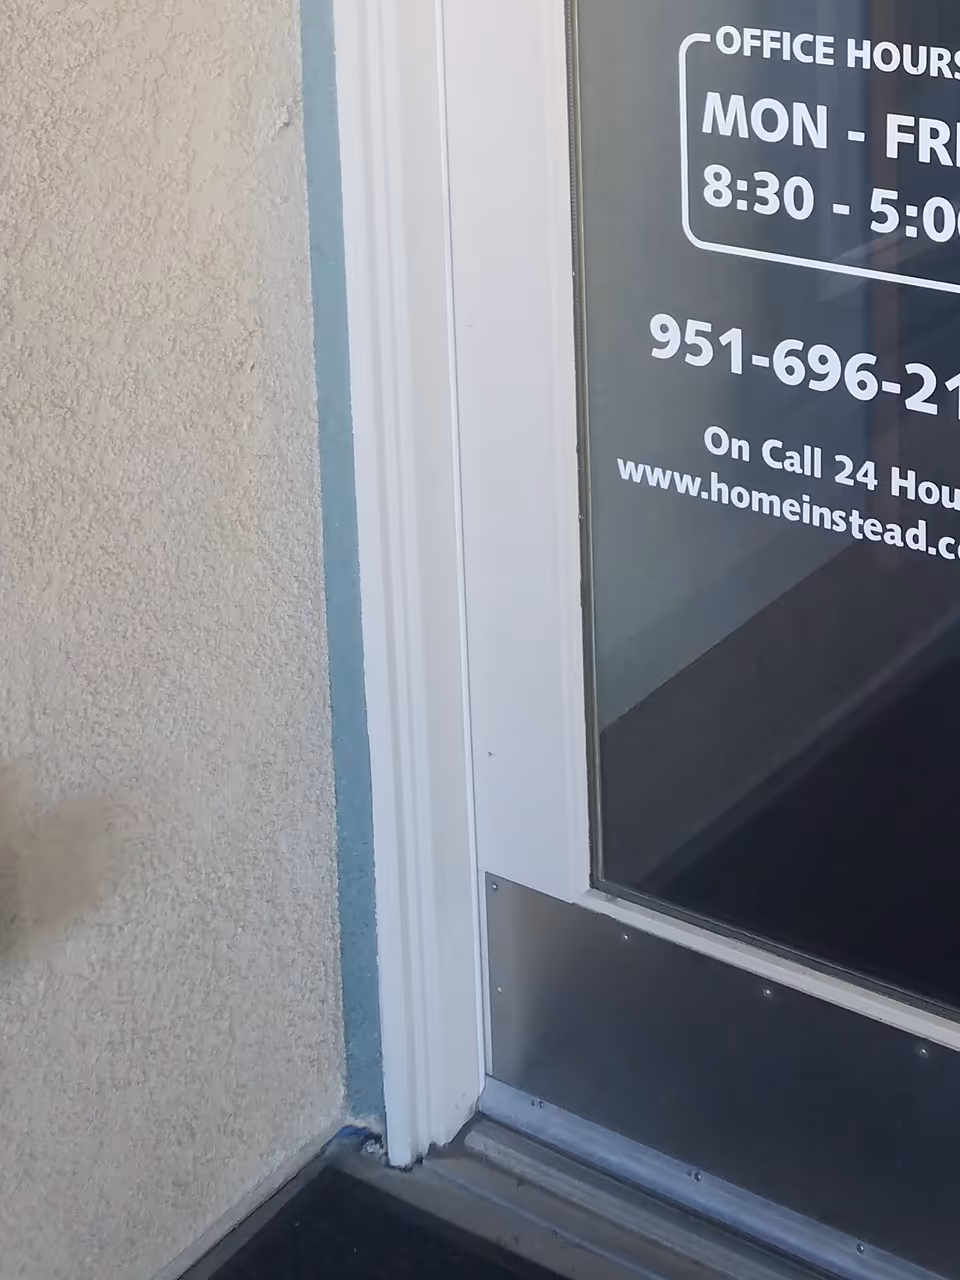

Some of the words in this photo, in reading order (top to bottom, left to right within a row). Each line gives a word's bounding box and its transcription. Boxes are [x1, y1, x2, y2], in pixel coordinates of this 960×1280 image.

[716, 25, 834, 65] OFFICE
[702, 92, 827, 149] MON
[848, 130, 865, 142] -
[703, 164, 814, 220] 8:30
[833, 203, 850, 215] -
[703, 425, 750, 462] On
[761, 439, 822, 478] Call
[834, 454, 878, 491] 24
